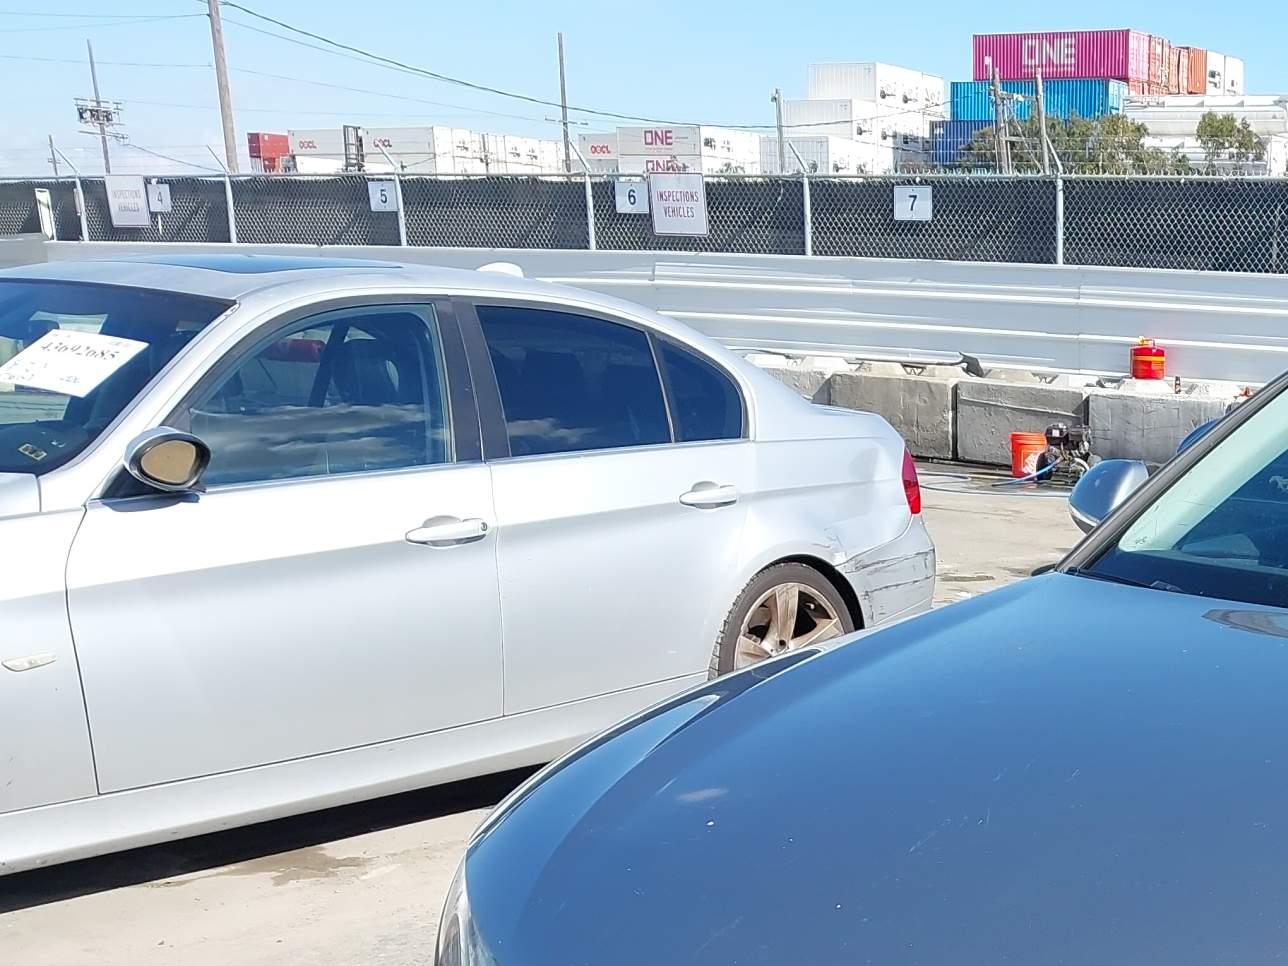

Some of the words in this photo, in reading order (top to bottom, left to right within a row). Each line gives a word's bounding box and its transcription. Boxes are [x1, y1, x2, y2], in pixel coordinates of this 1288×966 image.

[1022, 38, 1076, 65] ONE
[644, 129, 673, 146] ONE
[157, 191, 163, 205] 4
[379, 188, 388, 204] 5
[627, 189, 637, 205] 6
[656, 190, 699, 203] INSPECTIONS
[908, 194, 918, 211] 7
[663, 206, 695, 218] VEHICLES
